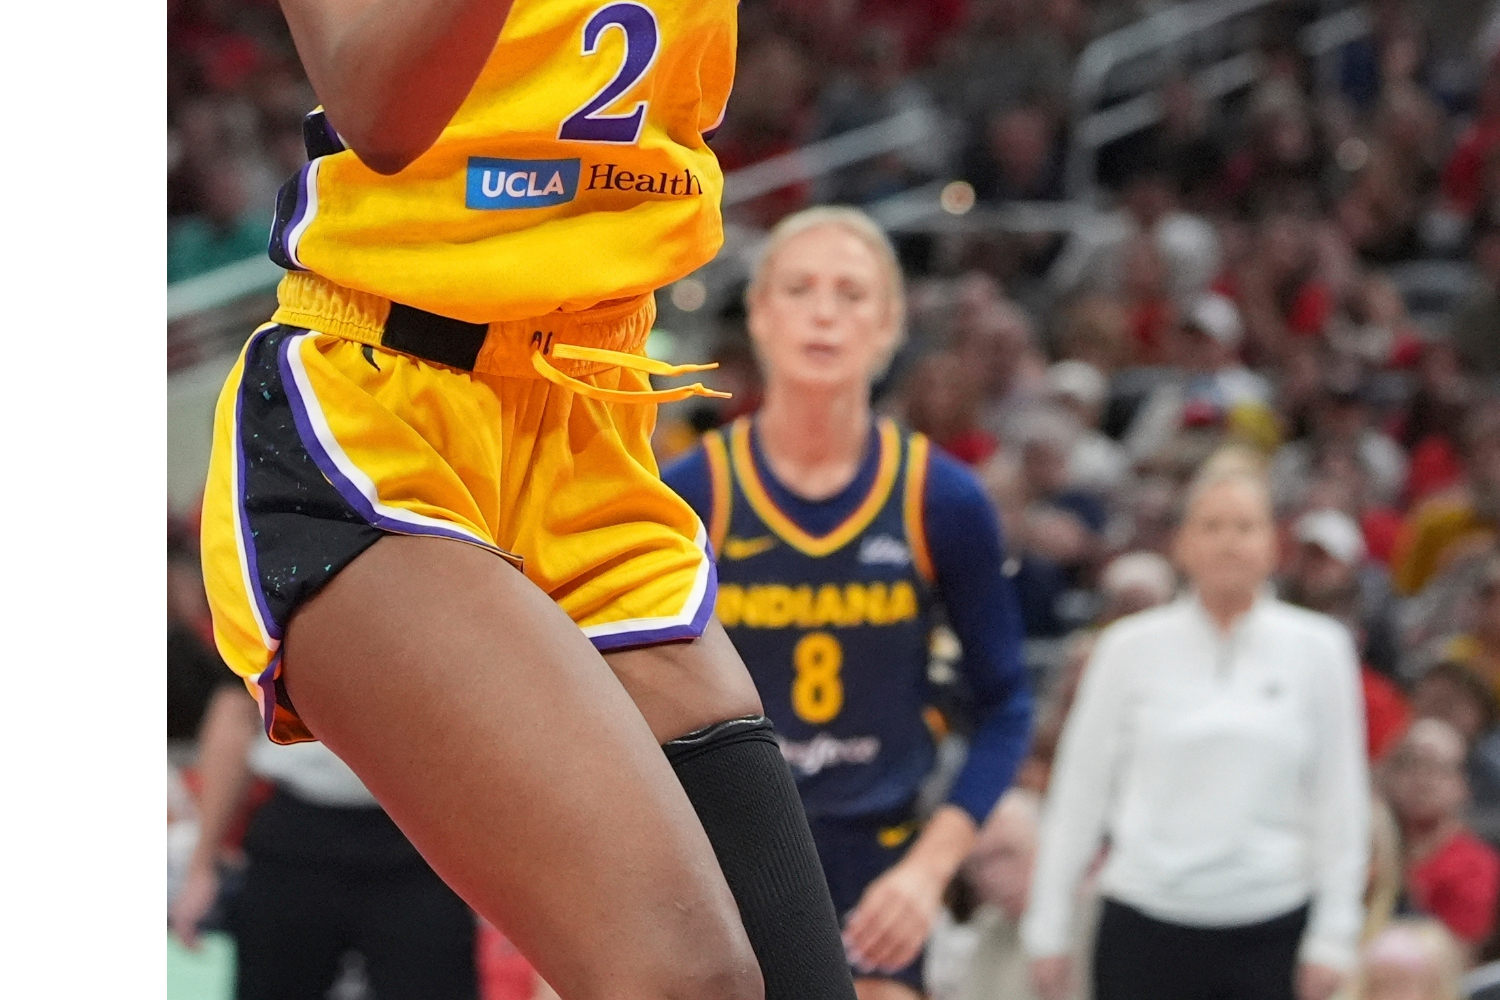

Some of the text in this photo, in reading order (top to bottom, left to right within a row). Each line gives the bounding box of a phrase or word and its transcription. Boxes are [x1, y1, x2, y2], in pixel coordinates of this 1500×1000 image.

[557, 1, 660, 144] 2
[481, 163, 703, 199] UCLA Health
[791, 630, 844, 725] 8
